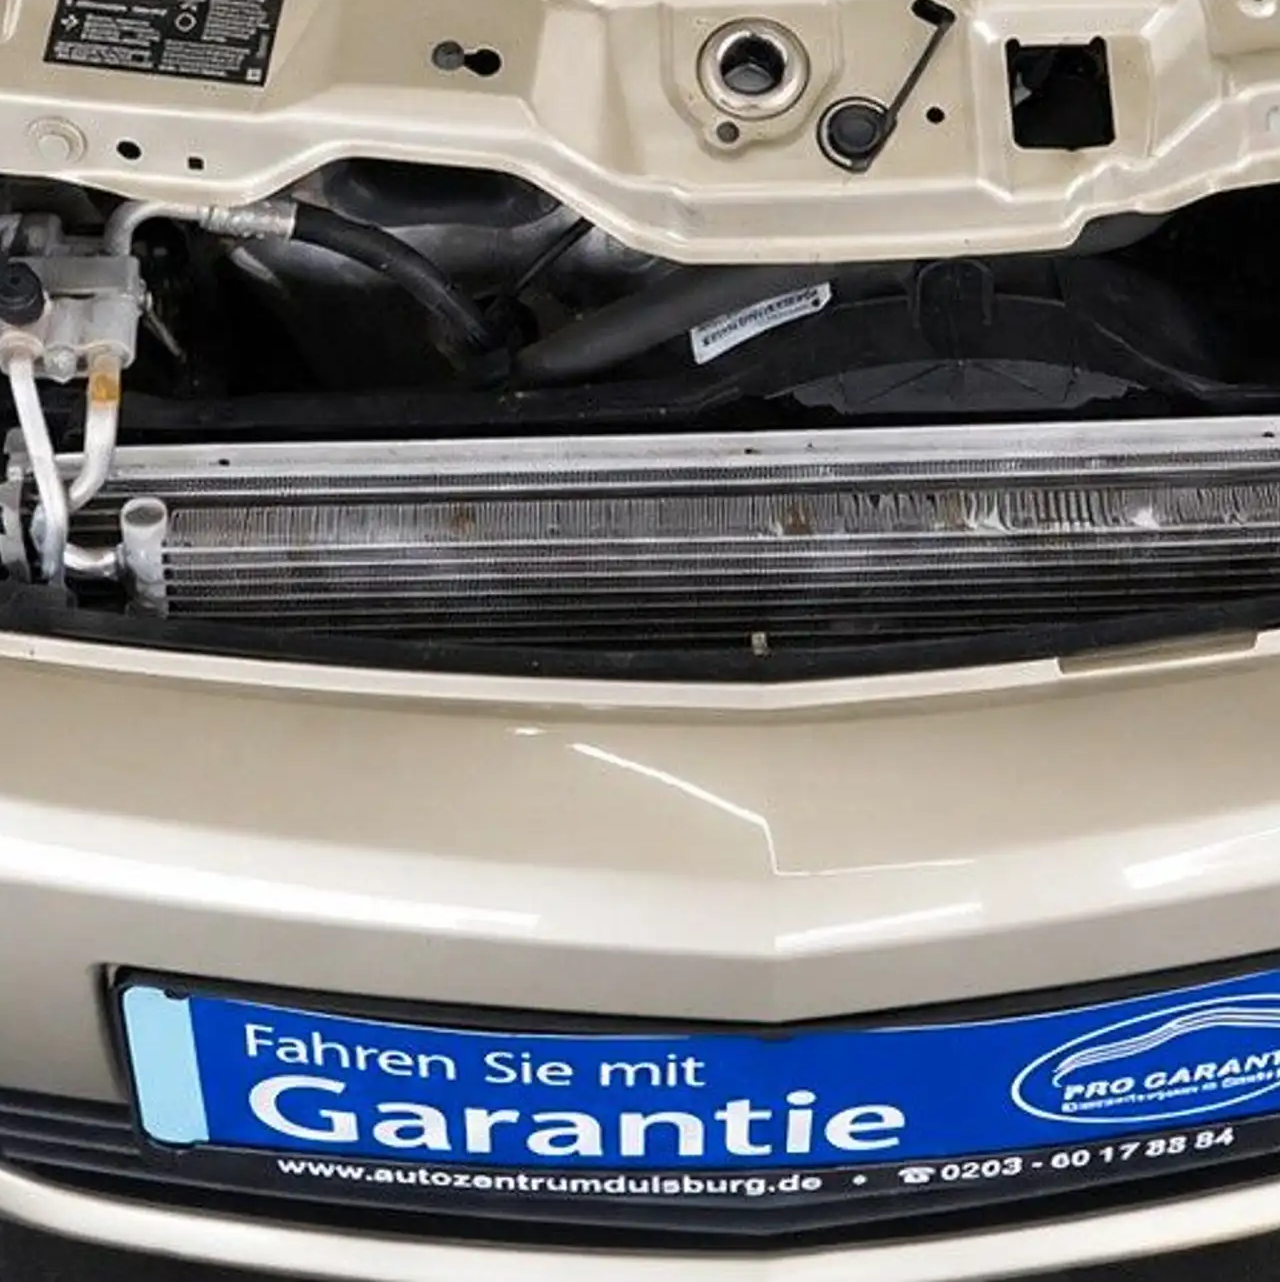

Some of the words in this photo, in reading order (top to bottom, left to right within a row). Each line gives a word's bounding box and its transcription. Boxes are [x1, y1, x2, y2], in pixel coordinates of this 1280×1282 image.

[245, 1023, 457, 1081] Fahren
[483, 1050, 574, 1087] Sie
[600, 1053, 706, 1088] mit
[247, 1074, 907, 1156] Garantie
[1063, 1076, 1136, 1101] PRO
[941, 1158, 1023, 1182] 0203
[1098, 1142, 1141, 1164] 17
[1193, 1126, 1235, 1149] 84
